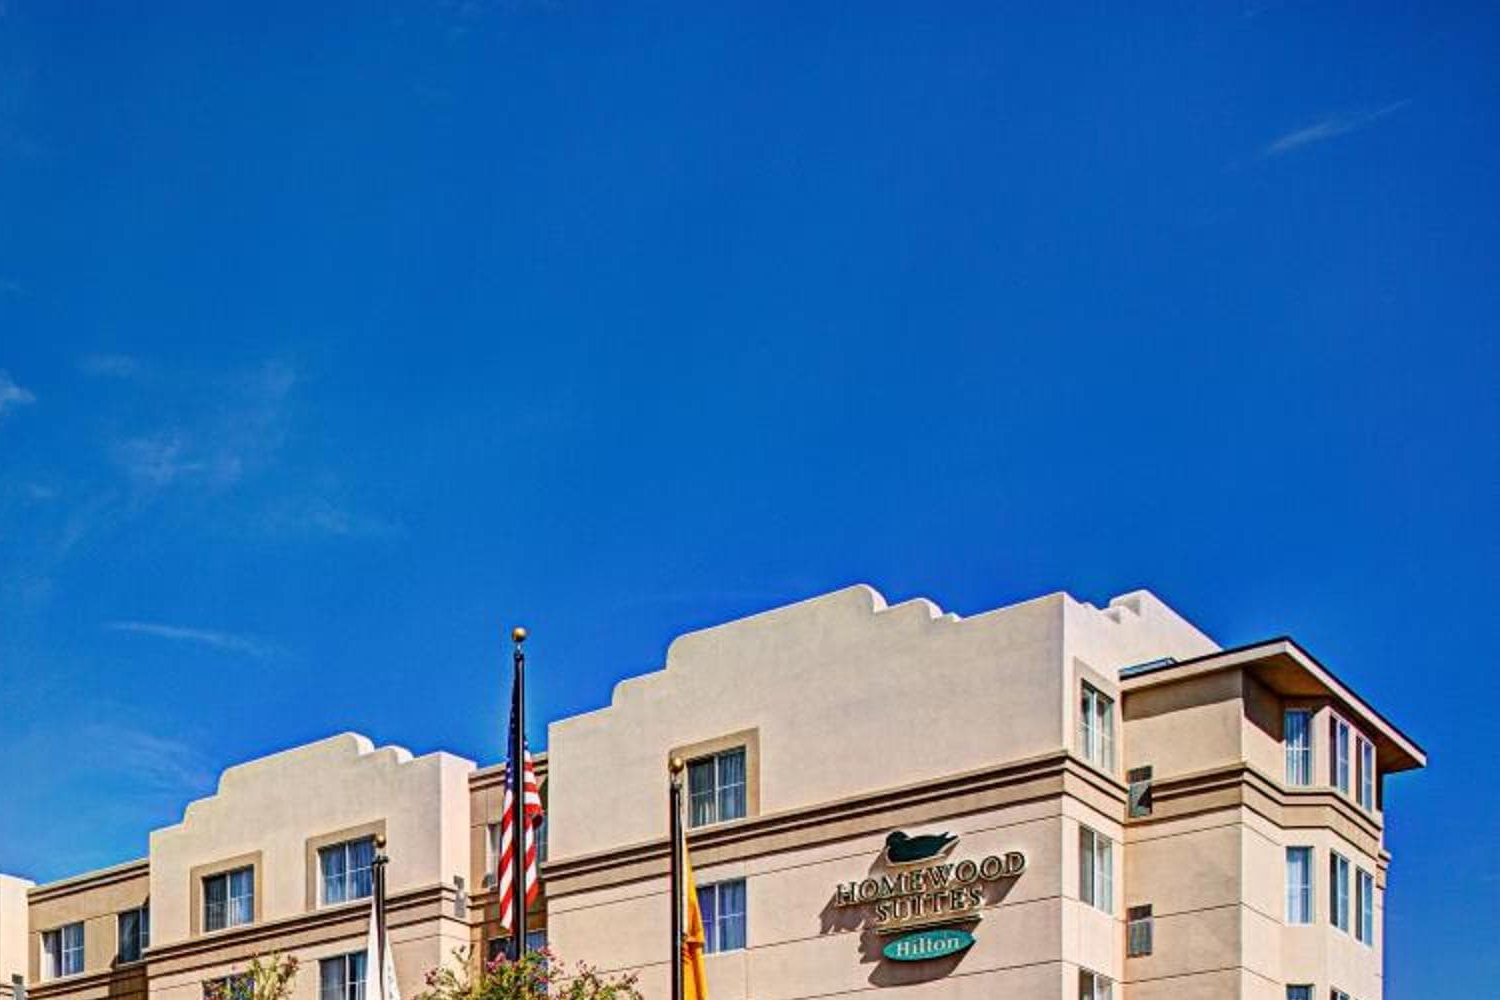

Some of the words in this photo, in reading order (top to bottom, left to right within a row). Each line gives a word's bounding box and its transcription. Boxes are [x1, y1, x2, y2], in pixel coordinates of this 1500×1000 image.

[835, 851, 1026, 905] HOMEWOOD
[875, 886, 983, 922] SUITES
[896, 937, 960, 957] Hilton
